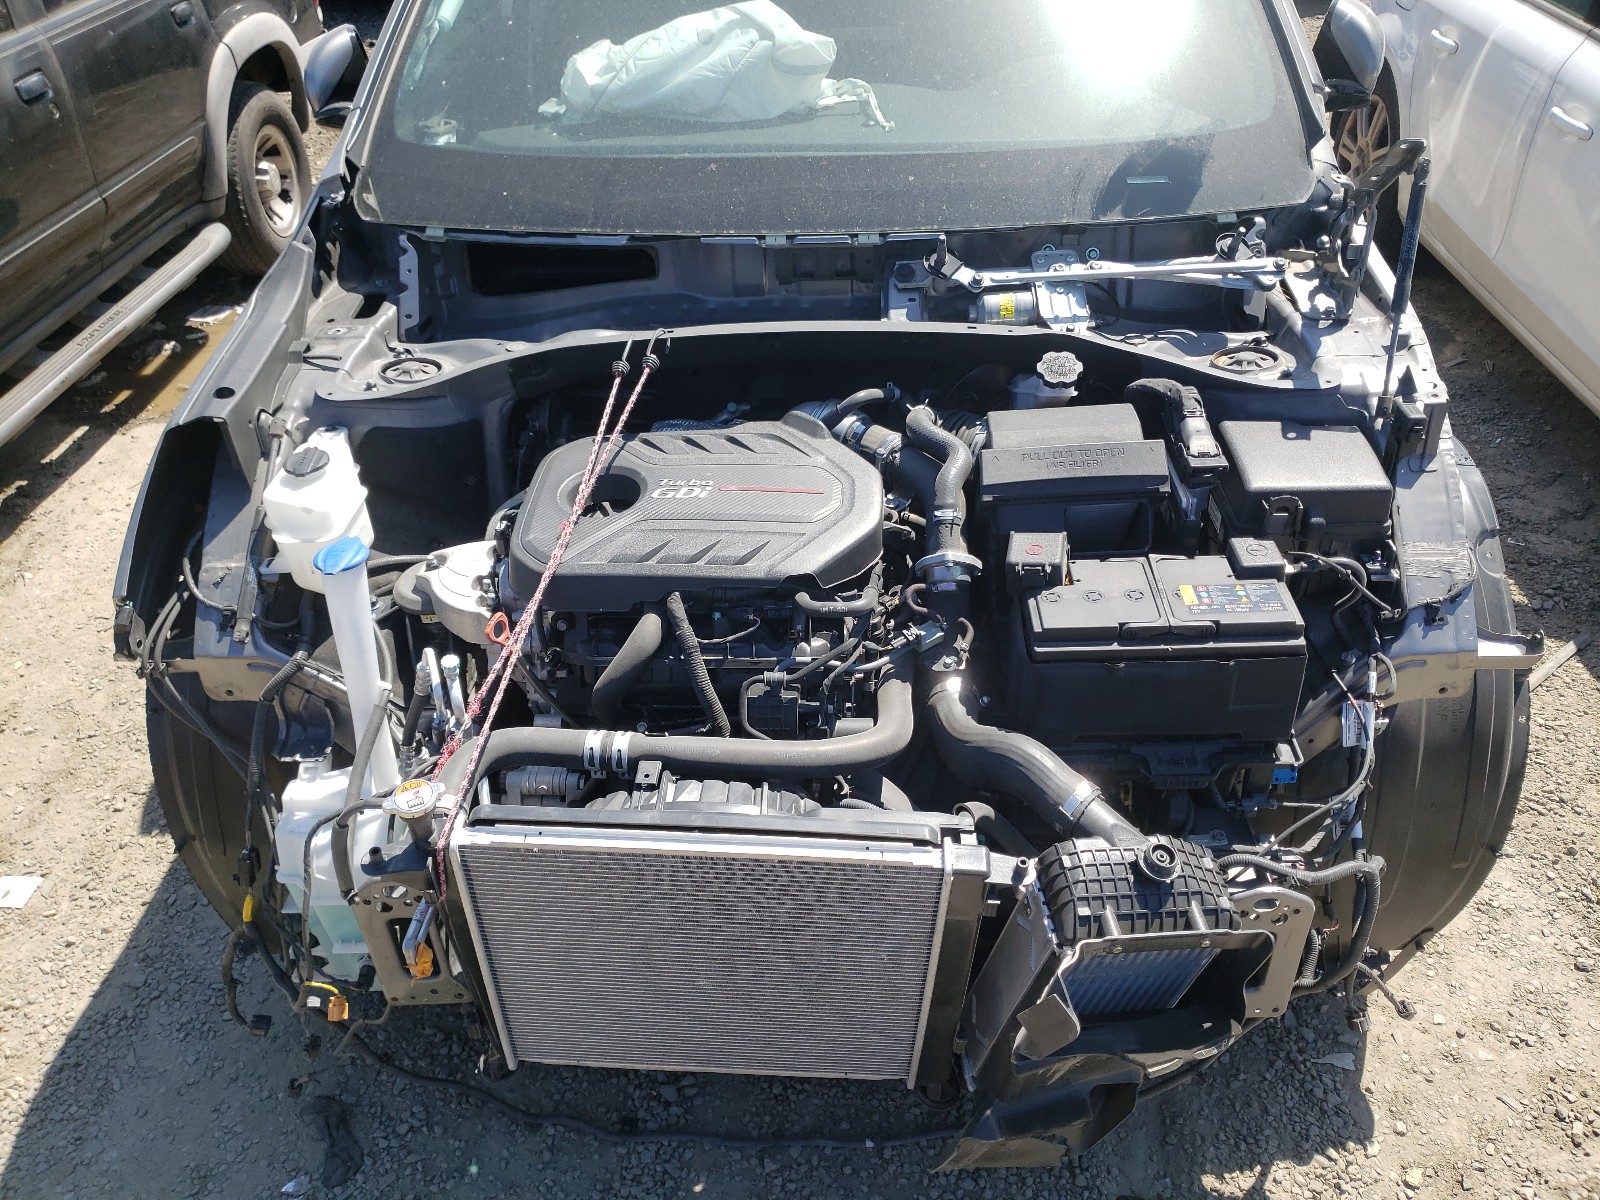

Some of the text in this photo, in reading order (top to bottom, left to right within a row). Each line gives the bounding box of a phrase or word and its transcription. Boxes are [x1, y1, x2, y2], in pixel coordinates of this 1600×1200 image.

[1021, 447, 1125, 461] PULL OUT TO OPEN
[659, 478, 714, 486] Turbo
[650, 486, 713, 499] GDi
